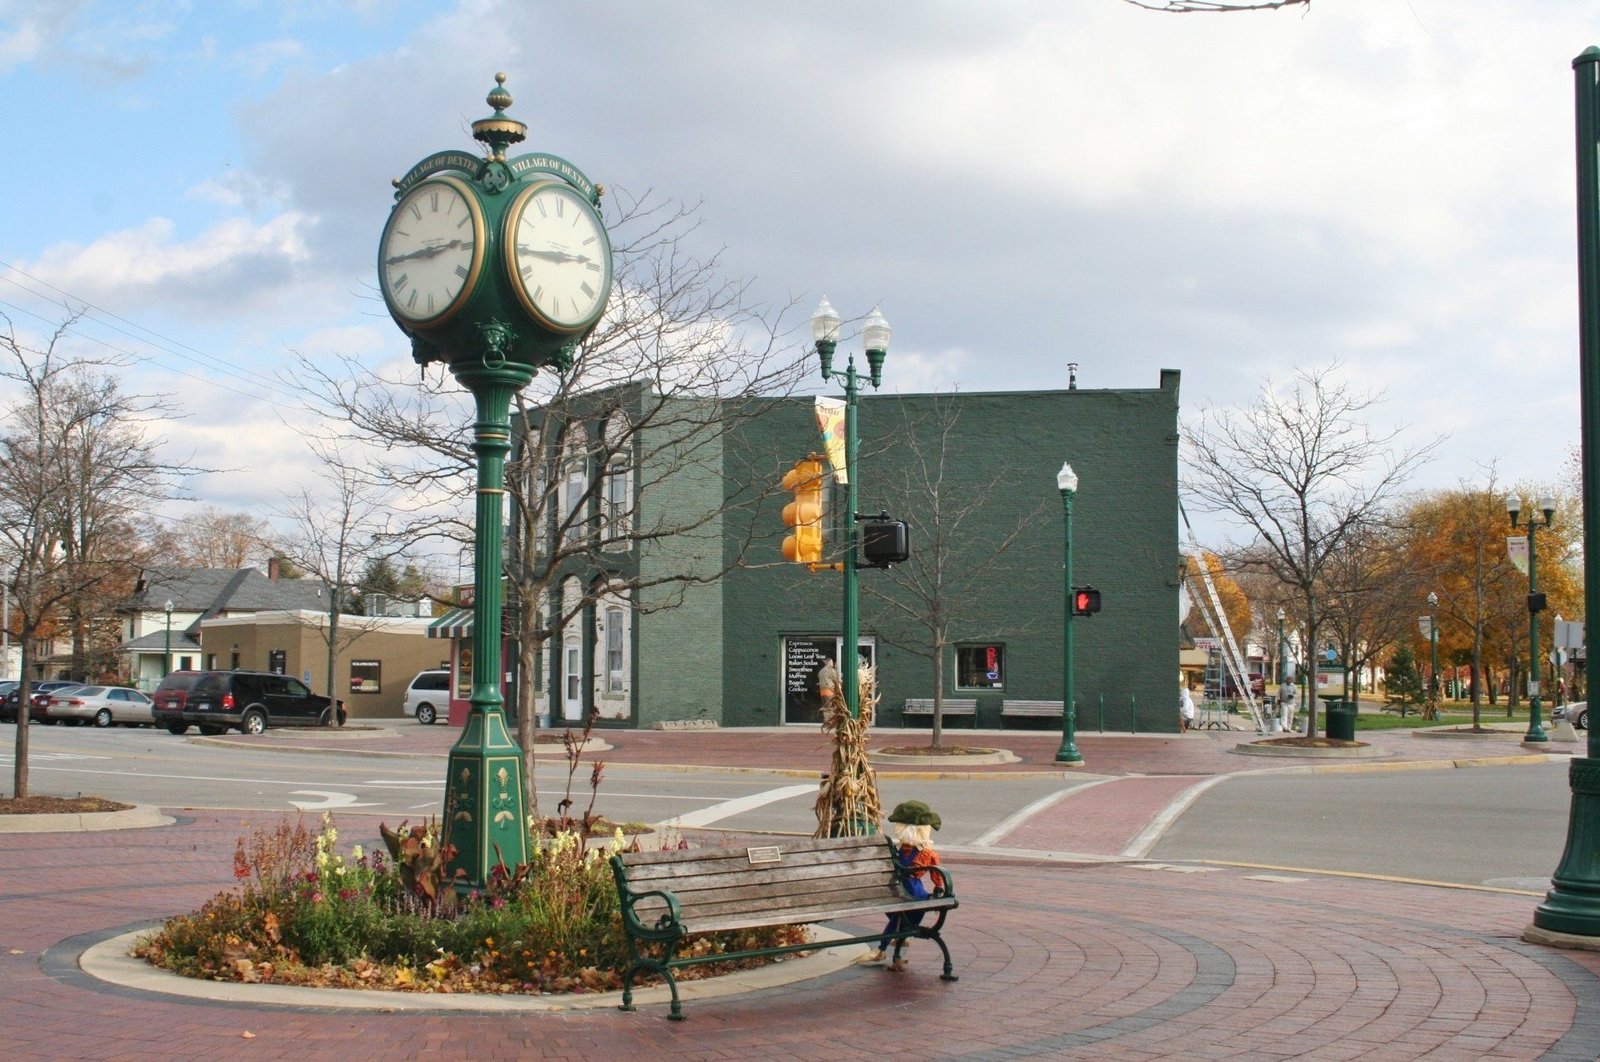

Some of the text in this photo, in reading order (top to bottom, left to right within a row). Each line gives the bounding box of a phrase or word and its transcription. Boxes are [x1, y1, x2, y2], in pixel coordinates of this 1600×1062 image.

[402, 156, 478, 188] VILLAGE OF DEXTER
[512, 157, 591, 194] VILLAGE OF DEXTER
